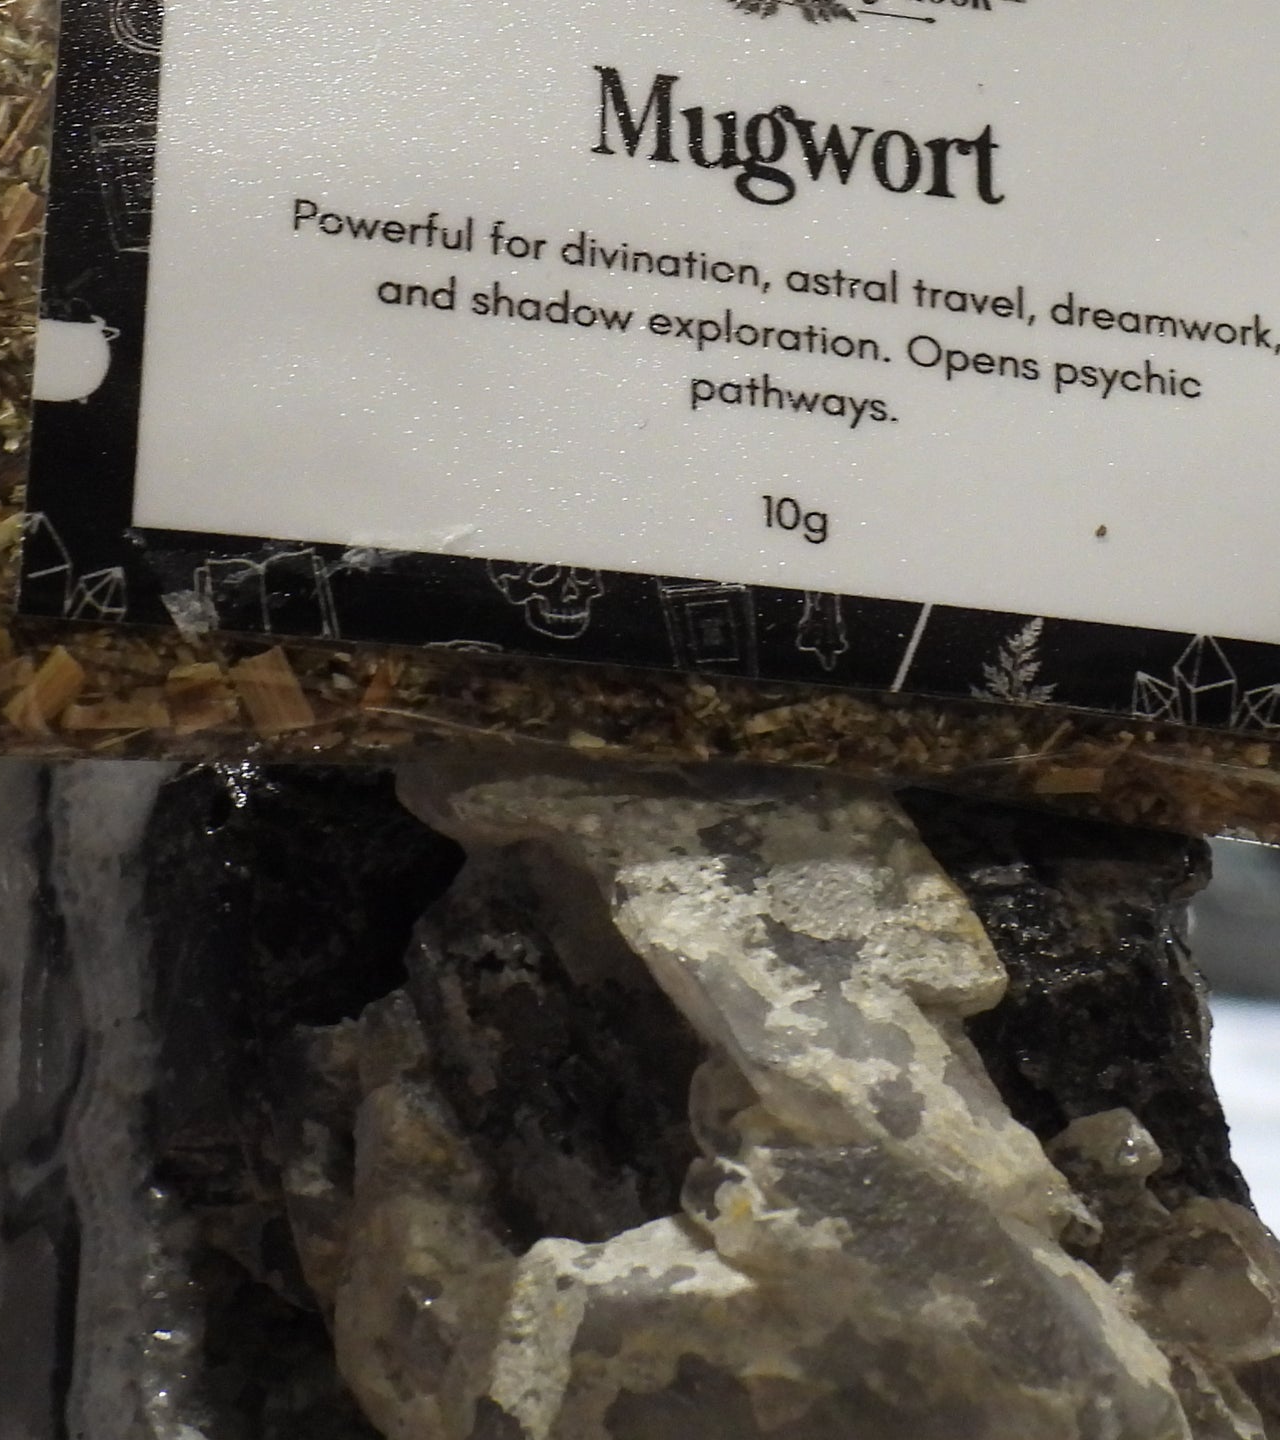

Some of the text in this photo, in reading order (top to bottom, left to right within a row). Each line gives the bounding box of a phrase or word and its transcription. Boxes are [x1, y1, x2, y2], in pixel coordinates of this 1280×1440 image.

[590, 64, 1006, 206] Mugwort
[292, 197, 474, 252] Powerful
[489, 220, 548, 261] for
[560, 229, 771, 295] divination,
[785, 259, 898, 305] astral
[912, 276, 1037, 328] travel,
[376, 274, 1203, 401] and shadow exploration. Opens psychic
[689, 372, 898, 430] pathways.
[761, 493, 829, 545] 10g
